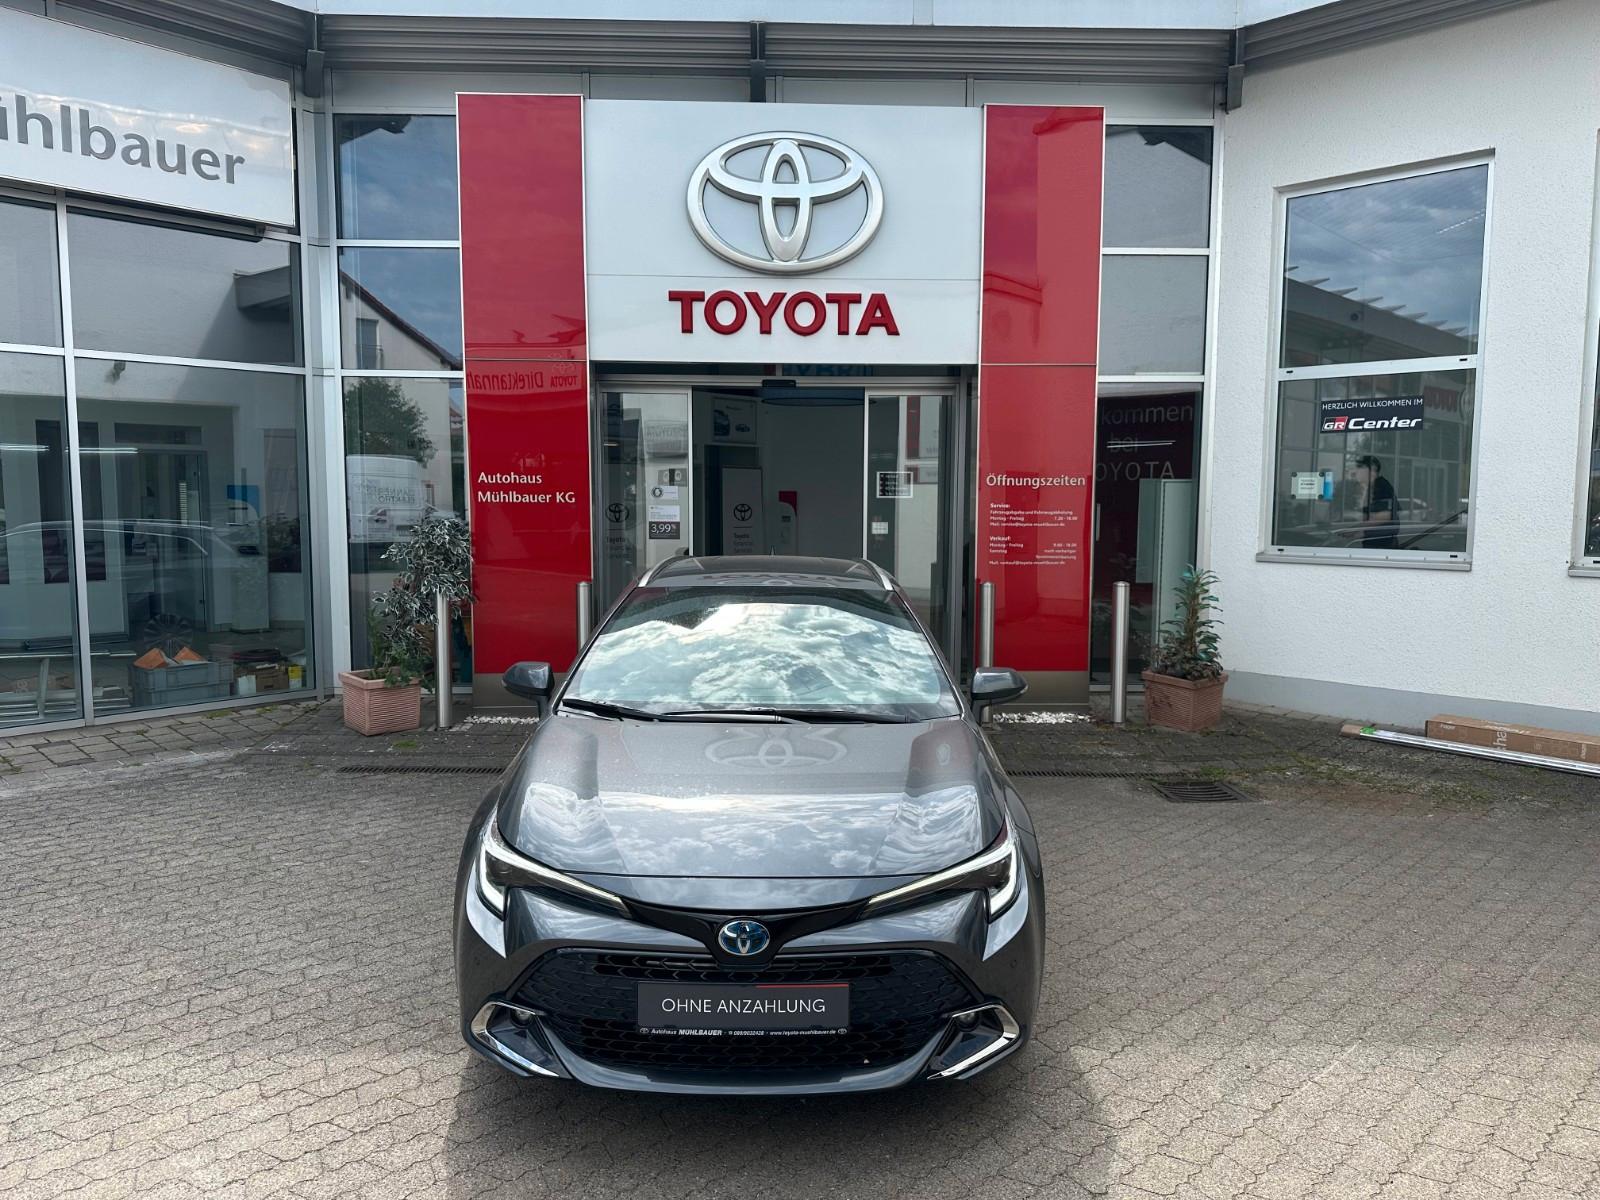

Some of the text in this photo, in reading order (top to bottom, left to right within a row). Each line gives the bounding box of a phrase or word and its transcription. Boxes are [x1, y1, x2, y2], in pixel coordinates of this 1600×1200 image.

[668, 290, 900, 336] TOYOTA
[1322, 398, 1424, 411] HERZLICH WILLKOMMEN IM
[1348, 416, 1422, 430] Center
[478, 472, 542, 485] Autohaus
[986, 472, 1086, 489] Öffnungszeiten
[478, 490, 576, 504] Mühlbauer KG
[661, 998, 826, 1014] OHNE ANZAHLUNG
